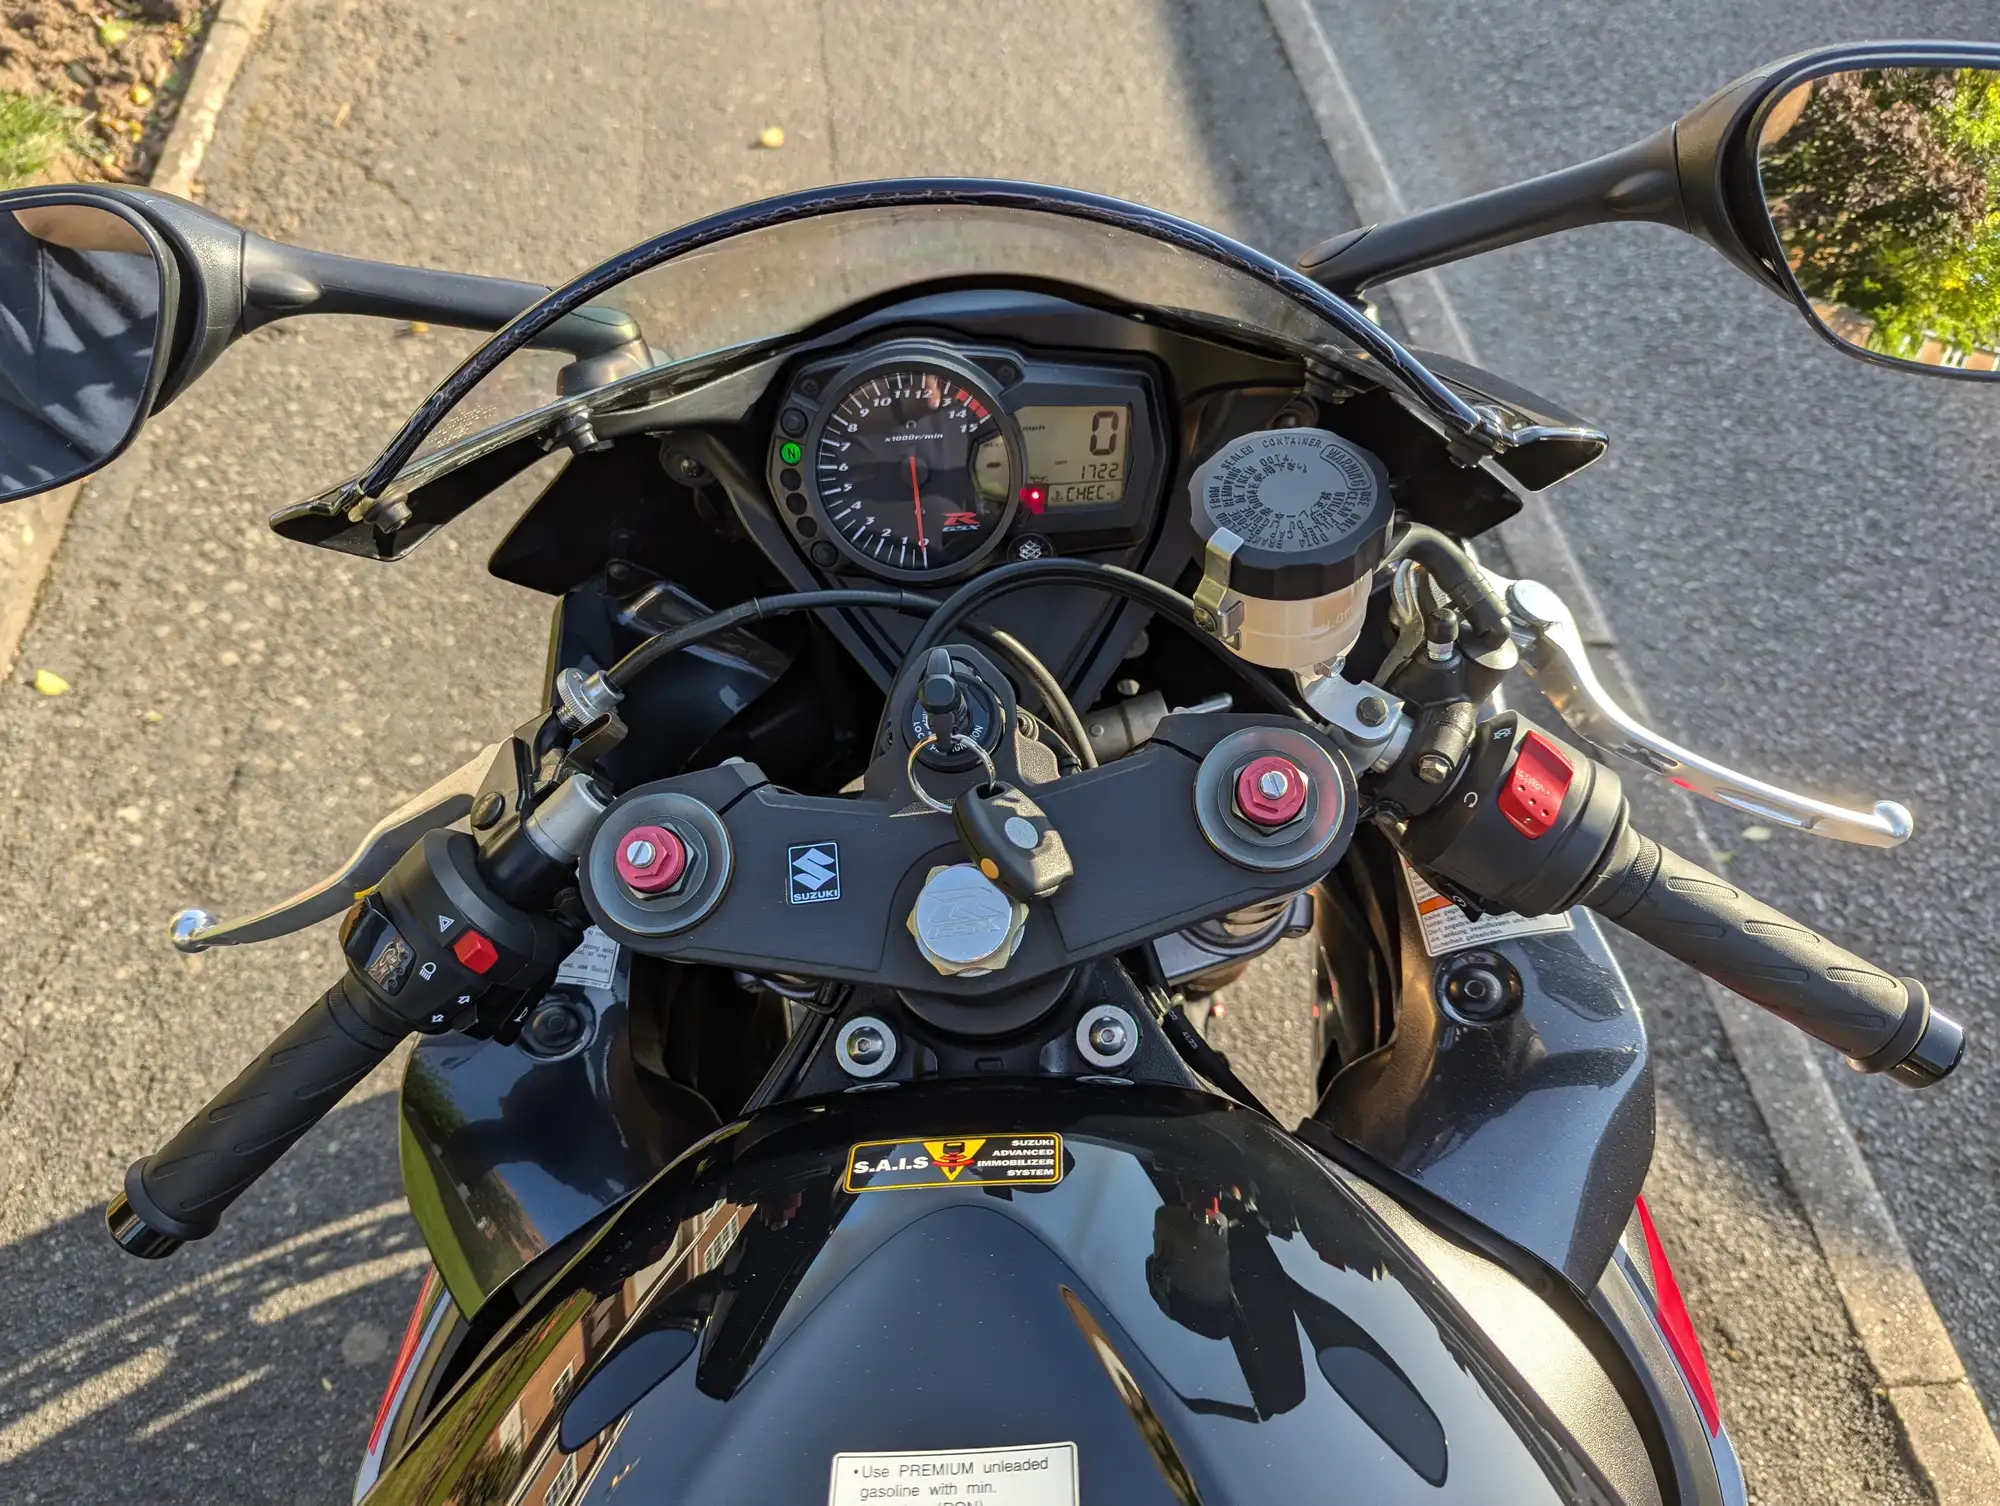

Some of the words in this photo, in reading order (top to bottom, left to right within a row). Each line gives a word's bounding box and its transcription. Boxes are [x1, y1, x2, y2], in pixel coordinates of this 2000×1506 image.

[894, 389, 911, 399] 11
[915, 390, 933, 399] 12
[873, 397, 892, 407] 10
[933, 398, 952, 408] 13
[860, 408, 870, 417] 9
[948, 409, 968, 419] 14
[848, 424, 858, 433] 8
[960, 423, 978, 433] 15
[1089, 410, 1119, 456] 0
[841, 441, 851, 451] 7
[788, 448, 796, 459] N
[1218, 445, 1255, 470] SEALED
[839, 463, 849, 471] 6
[1081, 463, 1119, 480] 1722
[1326, 447, 1367, 487] WARNING
[844, 483, 853, 492] 5
[1066, 484, 1105, 502] CHEC
[1207, 485, 1223, 508] FROM
[1356, 491, 1371, 507] USE
[851, 501, 862, 510] 4
[866, 516, 876, 525] 3
[943, 512, 980, 525] R
[881, 528, 891, 537] 2
[901, 536, 908, 544] 1
[918, 538, 930, 547] 0
[793, 889, 838, 901] SUZUKI
[1011, 1139, 1055, 1147] SUZUKI
[991, 1148, 1055, 1157] ADVANCED
[852, 1156, 929, 1174] S.A.I.S
[977, 1158, 1055, 1167] IMMOBILIZER
[1006, 1168, 1054, 1177] SYSTEM
[900, 1462, 974, 1477] PREMIUM
[983, 1457, 1049, 1474] unleaded
[860, 1484, 920, 1501] gasoline
[929, 1482, 958, 1496] with
[967, 1482, 997, 1495] min.
